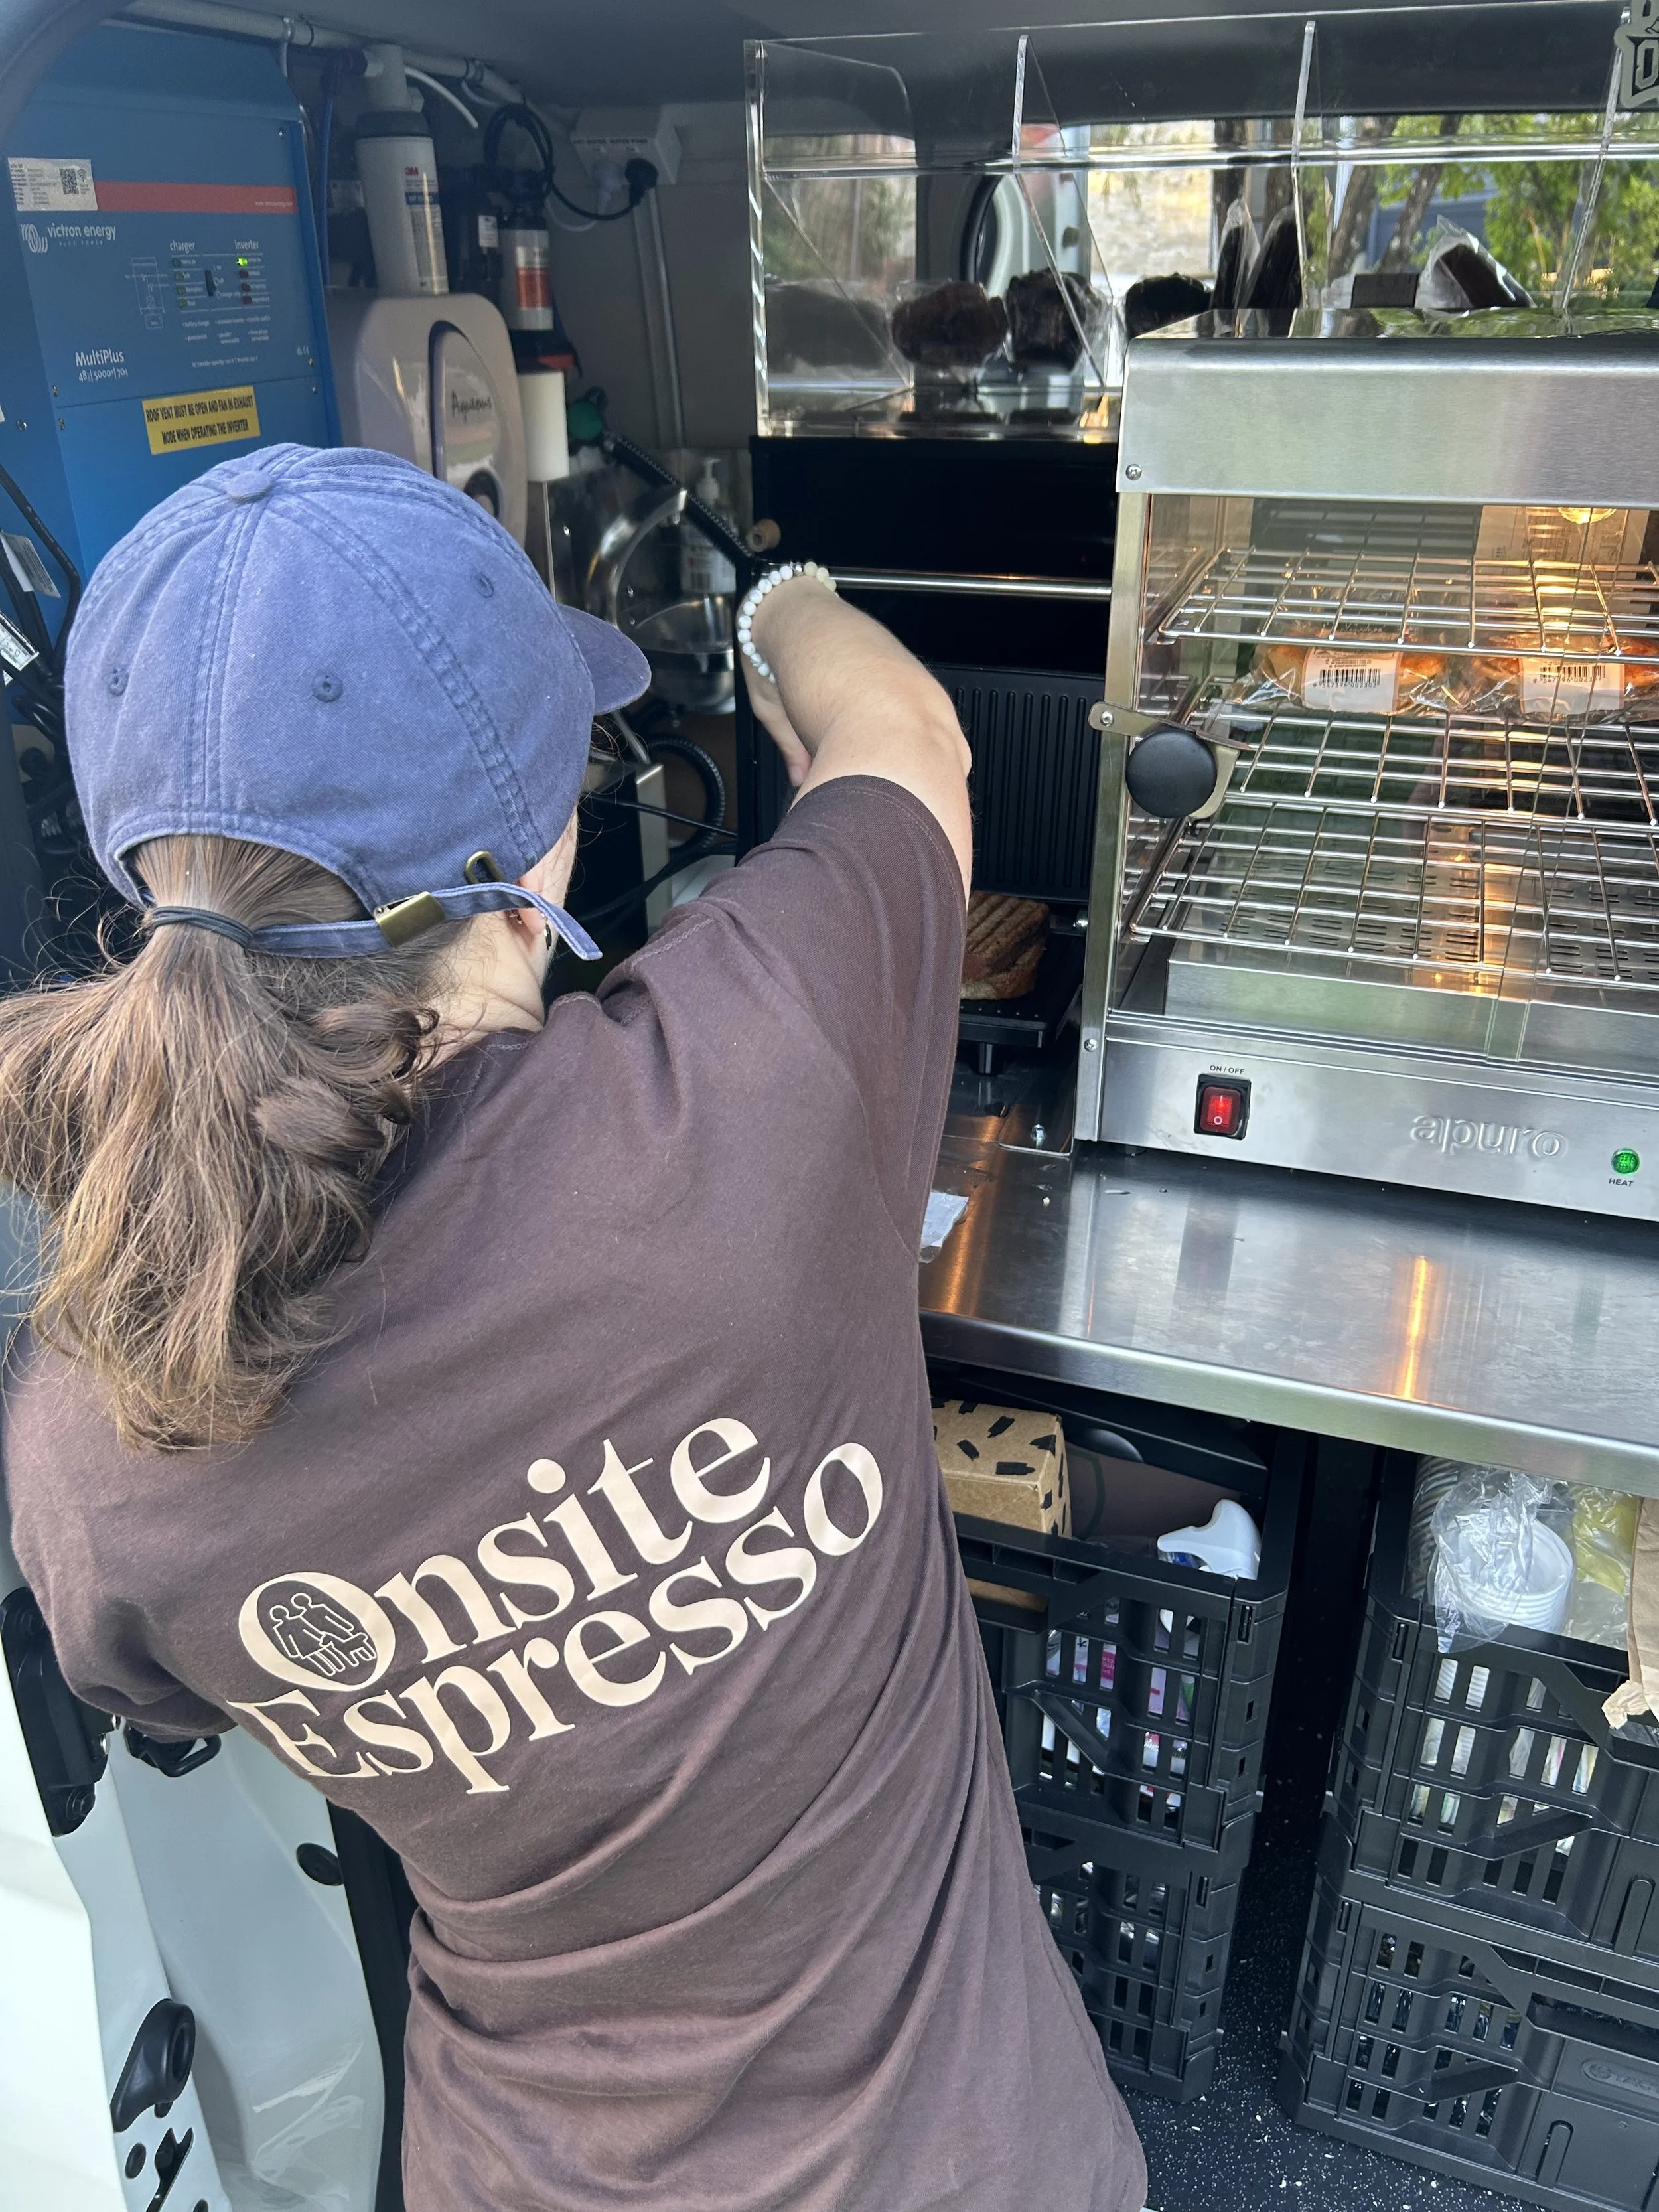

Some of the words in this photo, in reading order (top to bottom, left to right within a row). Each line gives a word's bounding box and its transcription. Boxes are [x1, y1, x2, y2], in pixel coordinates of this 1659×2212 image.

[47, 222, 82, 238] victron
[84, 226, 117, 240] energy
[170, 240, 196, 253] charger
[234, 239, 259, 250] inverter
[75, 348, 125, 367] MultiPlus
[145, 408, 160, 422] ROOF
[160, 406, 173, 420] VENT
[174, 404, 188, 419] MUST
[188, 403, 195, 416] BE
[195, 401, 208, 415] OPEN
[208, 400, 218, 413] AND
[218, 398, 228, 411] FAN
[234, 395, 254, 409] EXHAUST
[162, 430, 176, 445] MODE
[176, 428, 191, 441] WHEN
[191, 423, 217, 439] OPERATING
[217, 422, 226, 435] THE
[226, 418, 249, 433] INVERTER
[1409, 1114, 1568, 1156] apuro
[1609, 1177, 1634, 1187] HEAT
[239, 1418, 770, 1692] Onsite
[226, 1442, 883, 1795] Espresso
